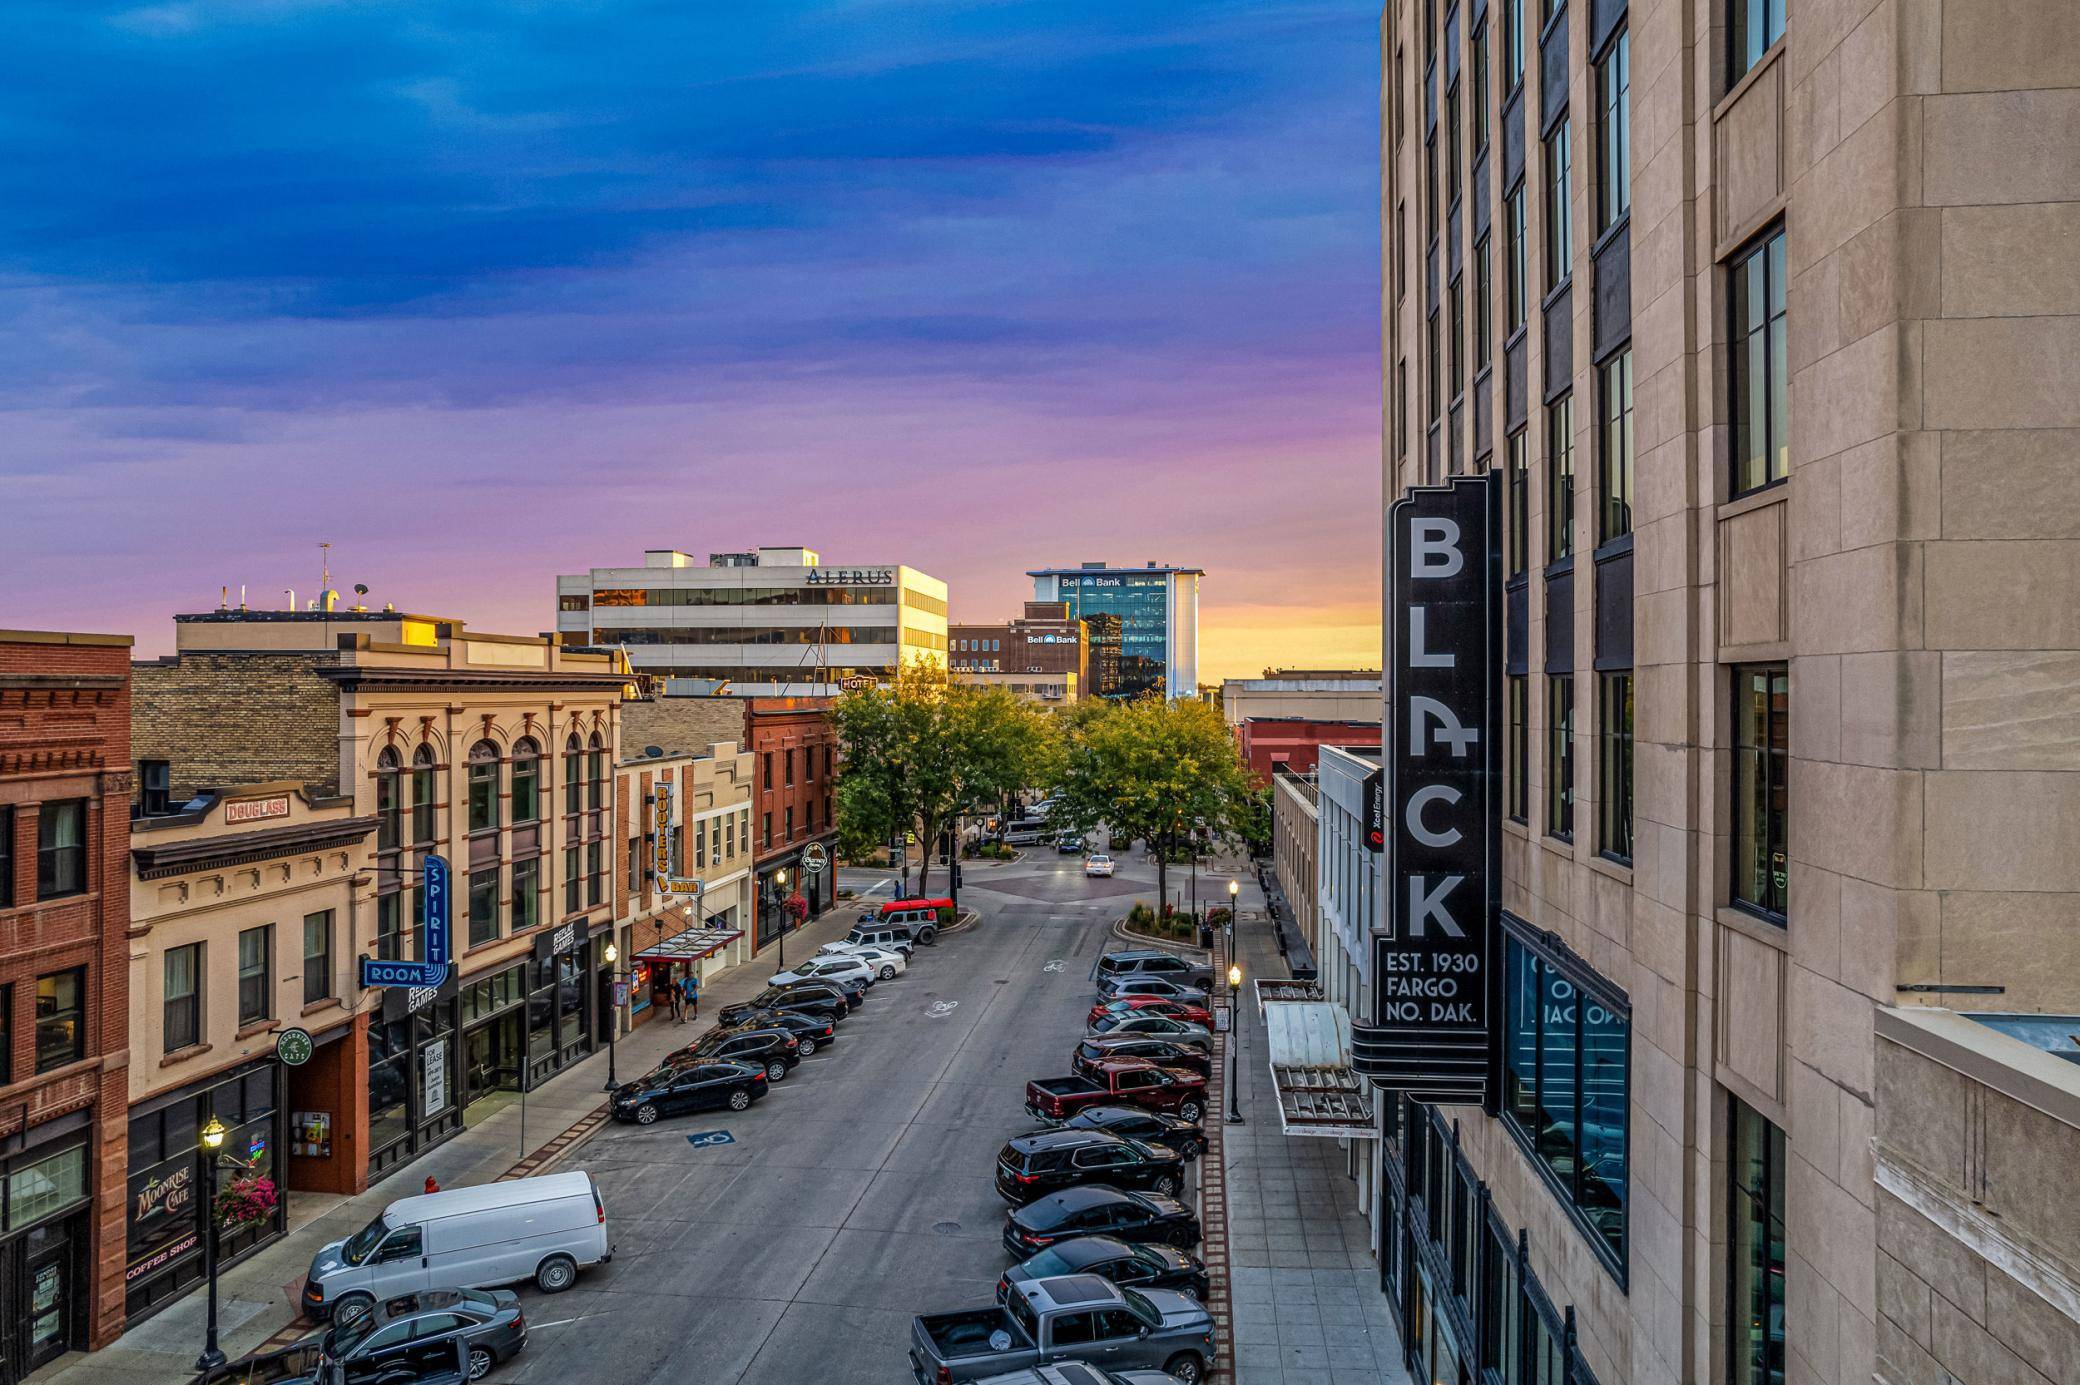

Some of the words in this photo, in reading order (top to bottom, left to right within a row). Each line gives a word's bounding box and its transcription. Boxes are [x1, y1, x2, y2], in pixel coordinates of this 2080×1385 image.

[806, 568, 892, 585] ALERUS
[1062, 578, 1080, 587] Bell
[1096, 577, 1121, 587] Bank
[1027, 635, 1044, 644] Bell
[1056, 635, 1078, 644] Bank
[843, 679, 876, 689] HOTEL
[1405, 516, 1479, 938] BLACK
[229, 799, 287, 820] DOUGLASS
[656, 786, 668, 874] ROOTERS
[671, 881, 699, 893] BAR
[430, 868, 441, 962] SPIRIT
[553, 922, 574, 946] REPLAY
[554, 932, 575, 955] GAMES
[1386, 952, 1424, 972] EST.
[1432, 952, 1479, 973] 1930
[371, 967, 422, 982] ROOM
[1386, 976, 1458, 998] FARGO
[408, 986, 438, 1013] GAMES
[1386, 1001, 1424, 1021] NO.
[1431, 1002, 1477, 1022] DAK.
[126, 1251, 168, 1280] COFFEE
[170, 1236, 198, 1257] SHOP
